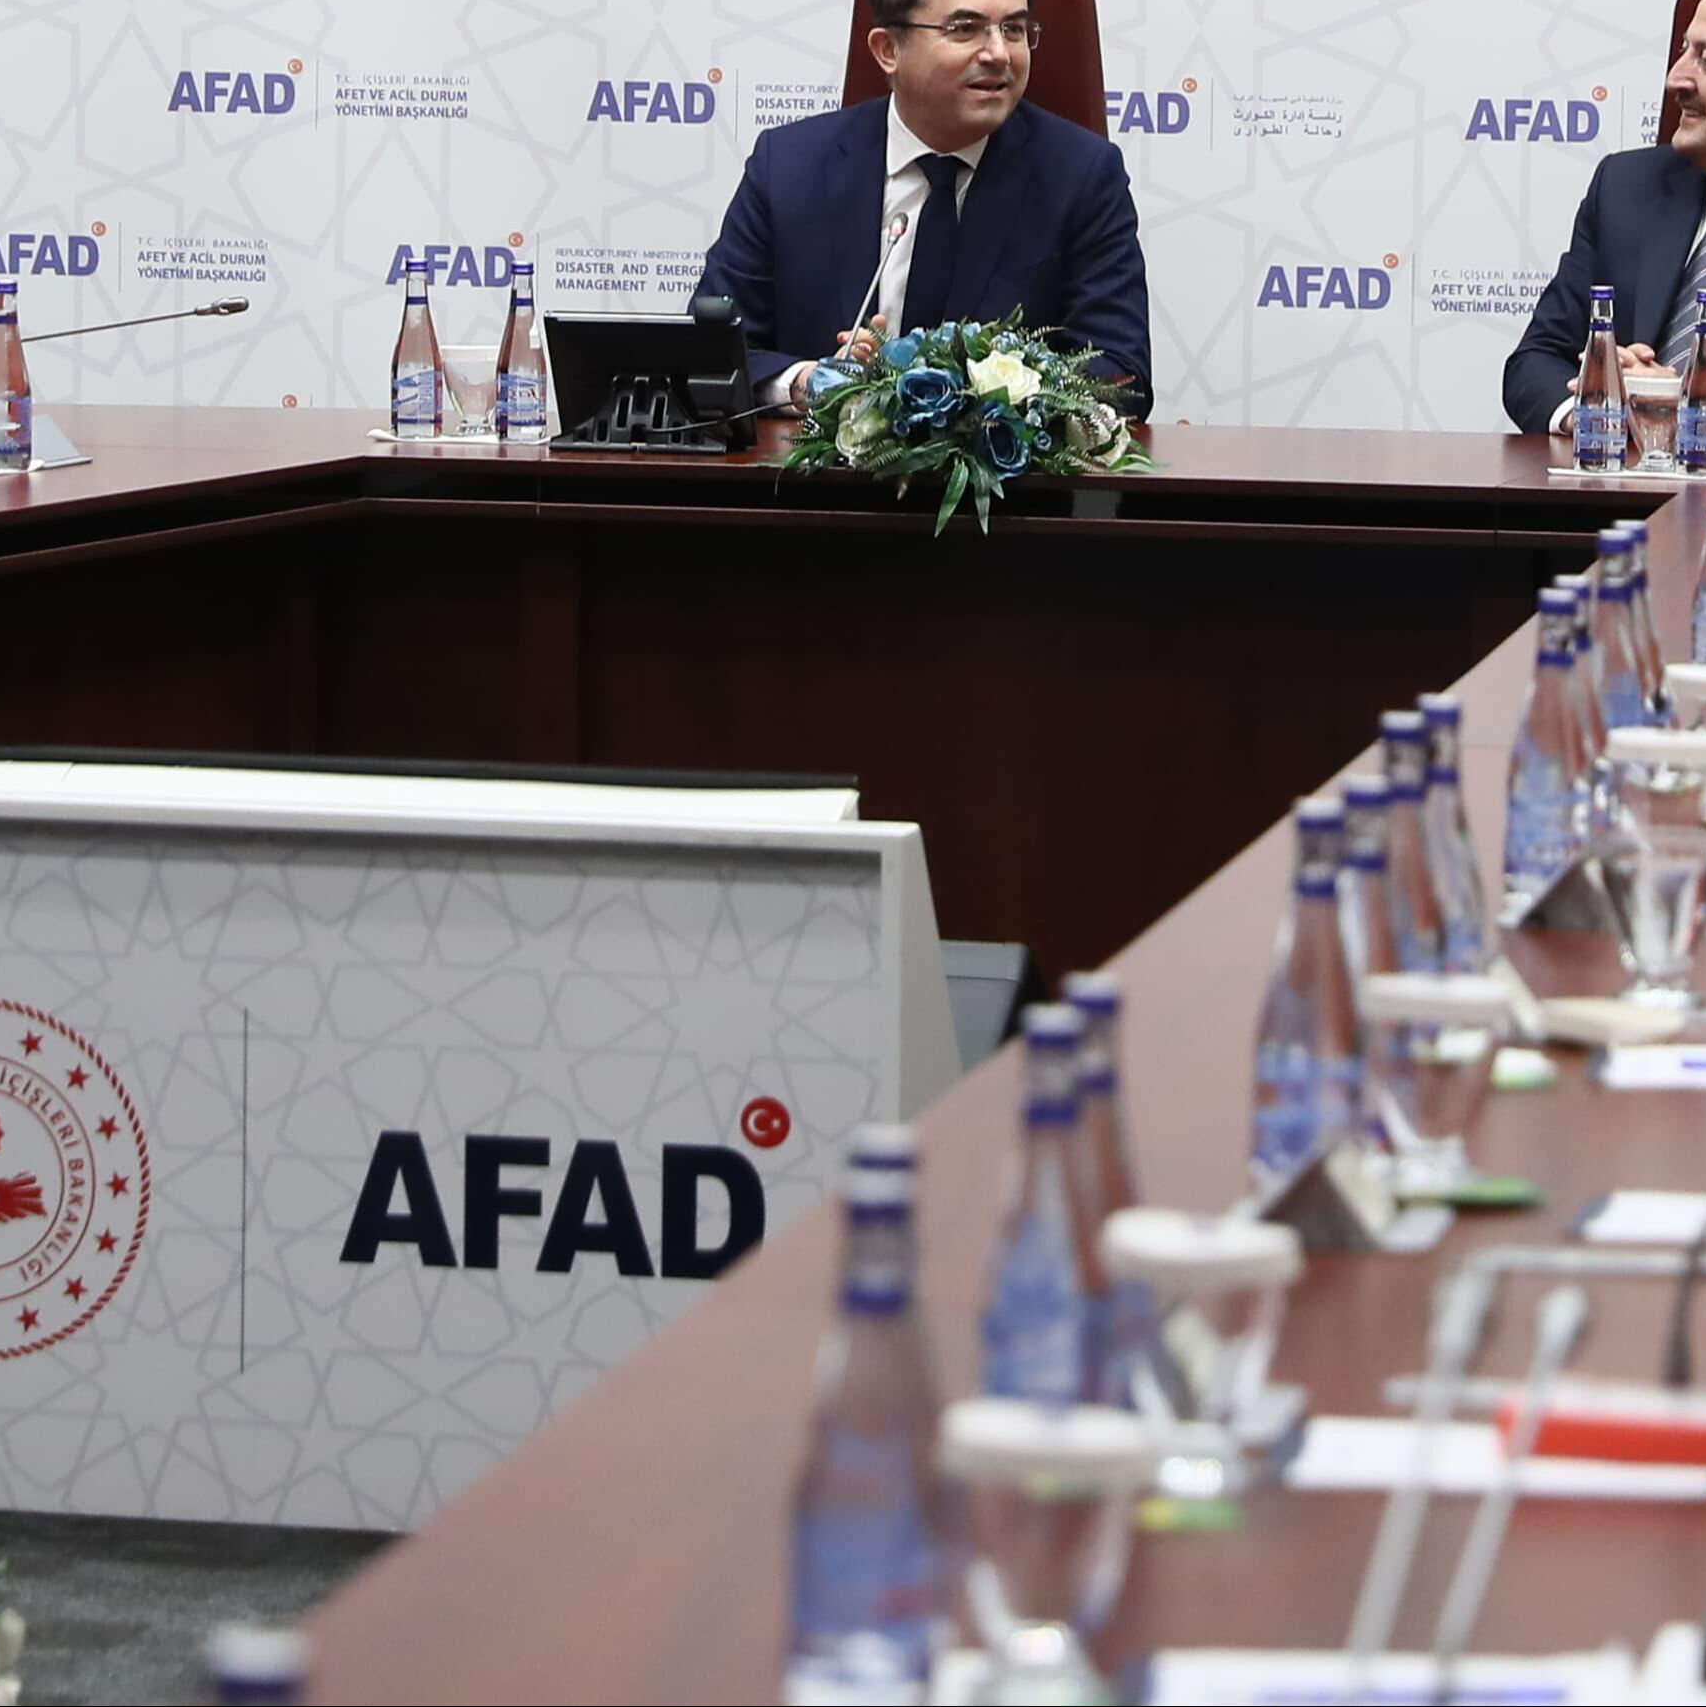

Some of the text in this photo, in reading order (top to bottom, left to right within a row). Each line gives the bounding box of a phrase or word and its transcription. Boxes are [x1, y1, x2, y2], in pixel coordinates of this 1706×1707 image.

[168, 71, 295, 114] AFAD
[335, 87, 468, 103] AFET VE ACİL DURUM
[587, 81, 716, 123] AFAD
[1465, 98, 1601, 142] AFAD
[385, 245, 517, 287] AFAD
[1257, 266, 1392, 309] AFAD
[0, 1066, 80, 1150] İÇİŞLERİ
[19, 1157, 84, 1282] BAKANLIĞI
[339, 1131, 766, 1281] AFAD
